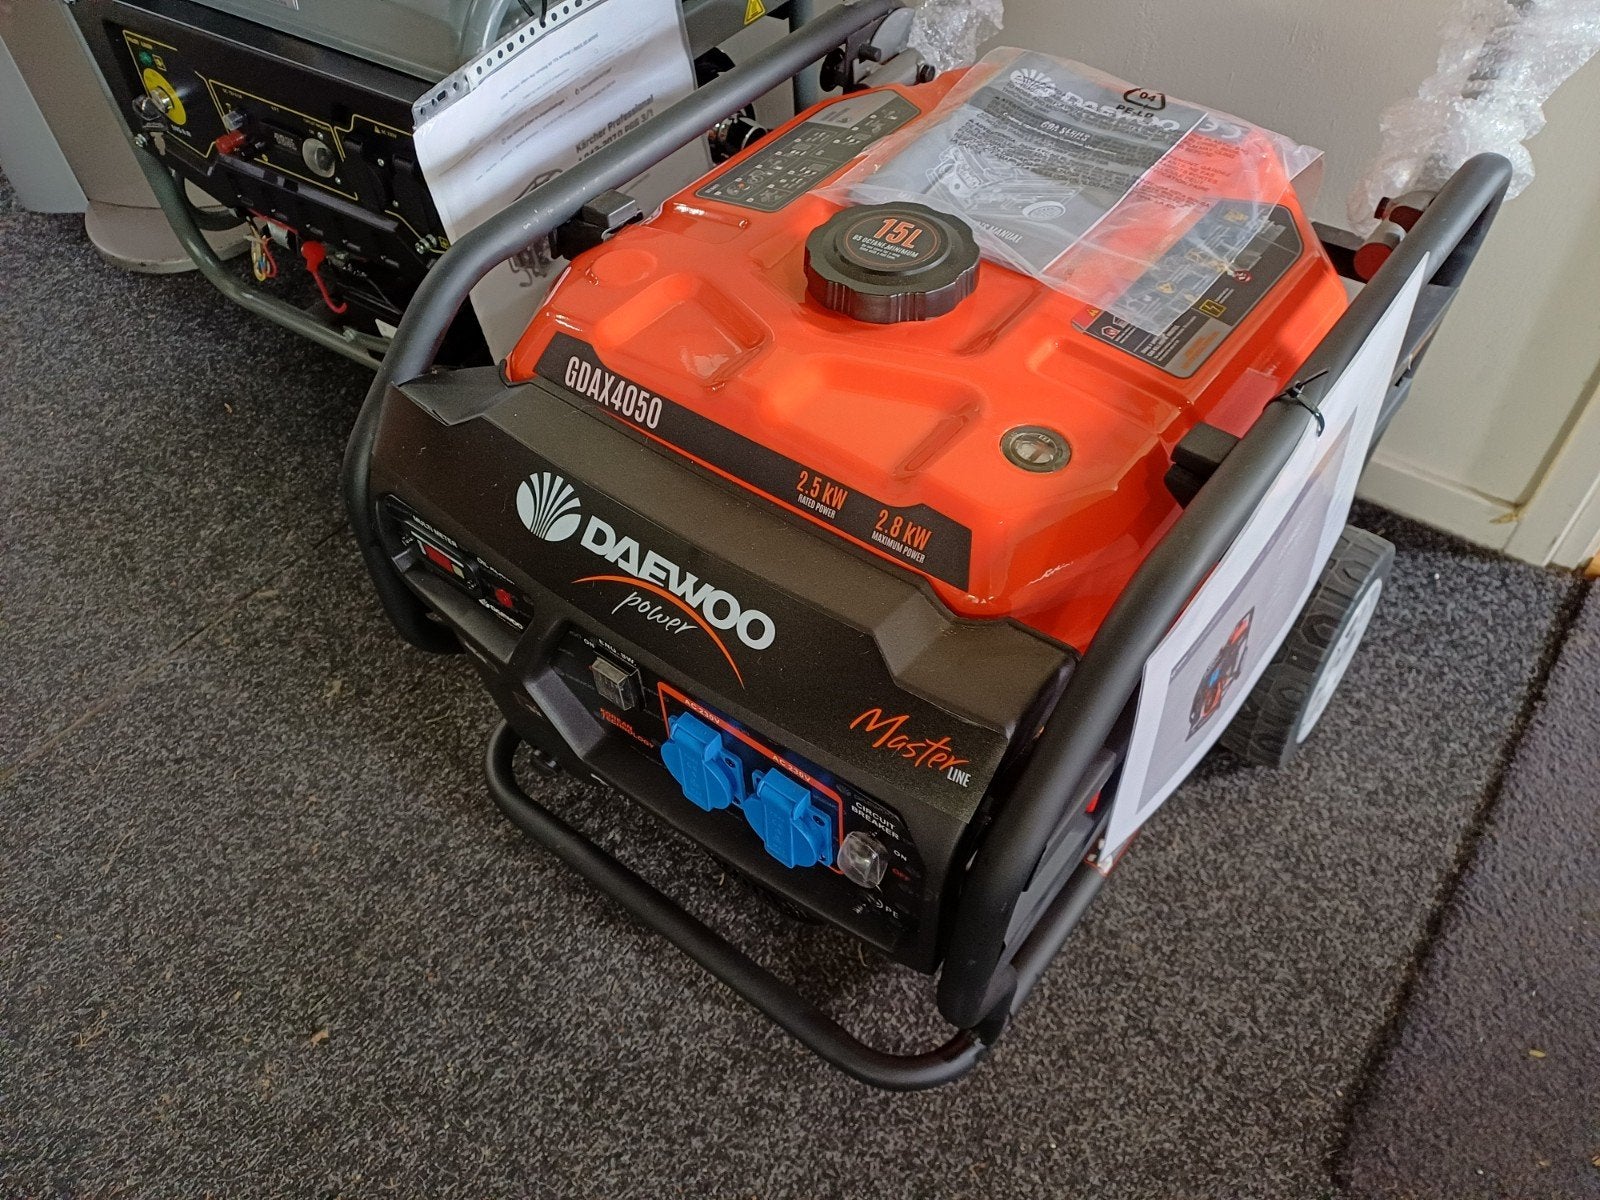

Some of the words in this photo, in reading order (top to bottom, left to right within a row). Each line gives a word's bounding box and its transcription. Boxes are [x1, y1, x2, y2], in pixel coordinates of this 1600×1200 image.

[1139, 91, 1157, 102] 04
[575, 127, 606, 153] Kärcher
[607, 94, 654, 131] Professional
[861, 237, 887, 248] OCTANE
[884, 243, 919, 258] MINIMUM
[874, 218, 923, 249] 15L
[564, 356, 663, 431] GDAX4050
[796, 470, 823, 498] 2.5
[797, 493, 816, 509] RATED
[815, 501, 836, 519] POWER
[875, 509, 904, 538] 2.8
[871, 530, 904, 552] MAXIMUM
[902, 546, 926, 564] POWER
[580, 514, 776, 651] DAEWOO
[611, 590, 698, 637] power
[849, 708, 970, 773] Master
[946, 767, 972, 789] LINE
[851, 805, 901, 841] BREAKER
[855, 801, 896, 830] CIRCUIT
[893, 849, 907, 862] ON
